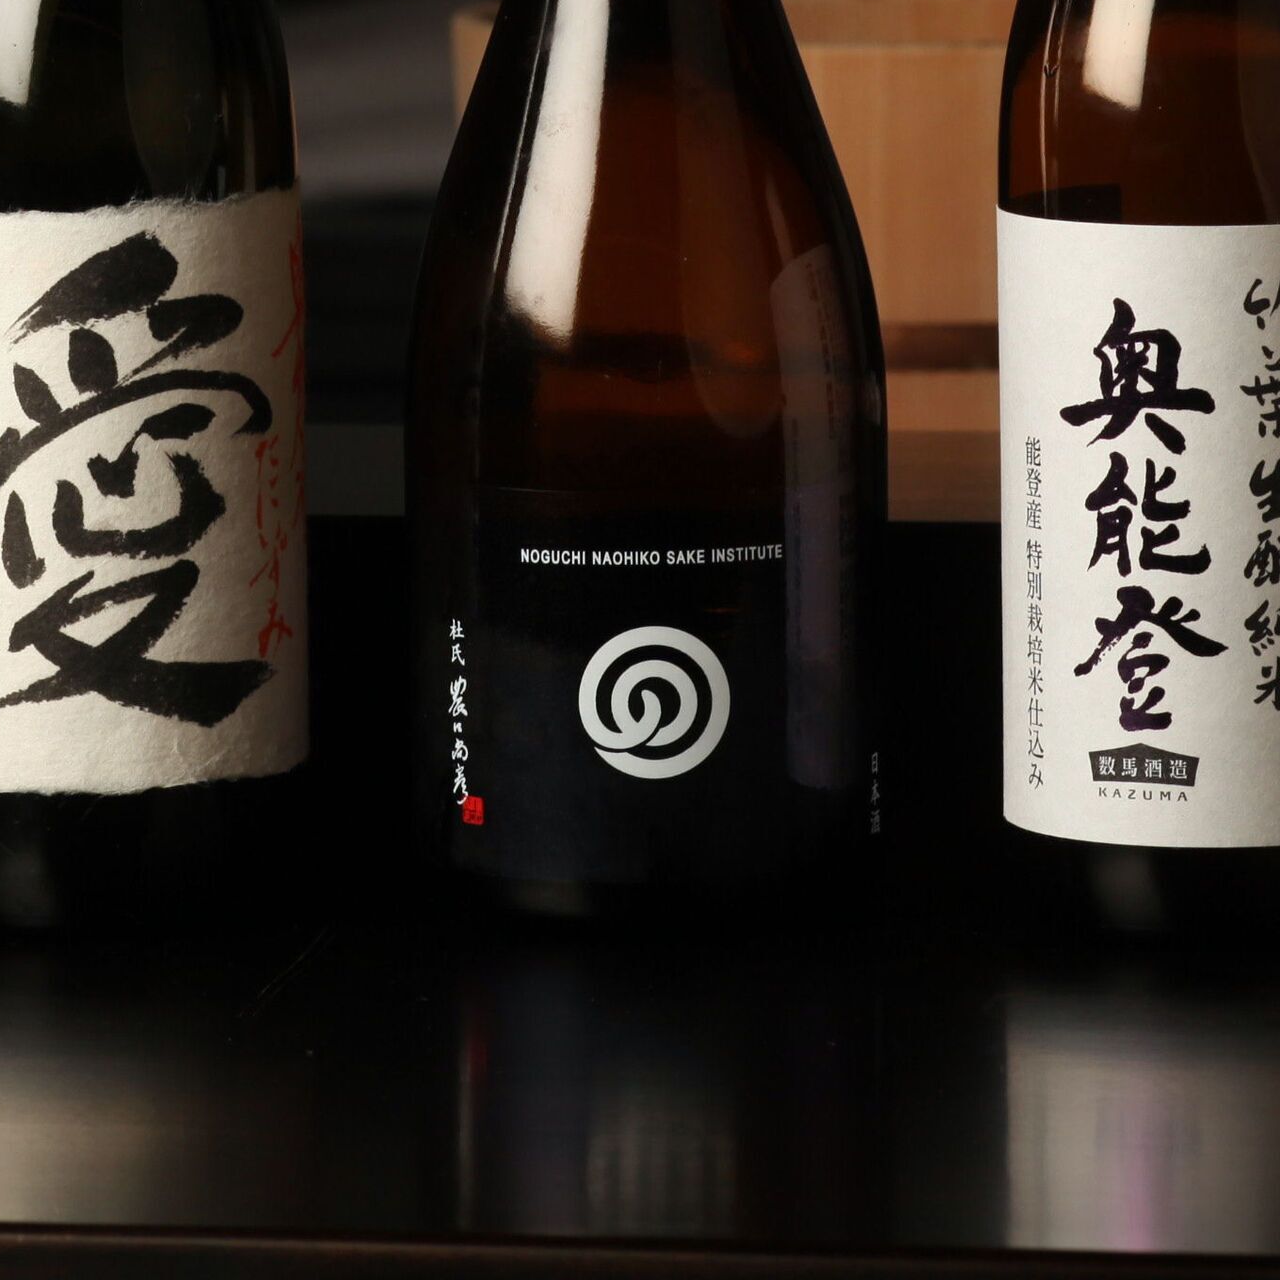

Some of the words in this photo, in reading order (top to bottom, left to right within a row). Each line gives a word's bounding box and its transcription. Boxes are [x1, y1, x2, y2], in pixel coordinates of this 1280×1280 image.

[1024, 436, 1043, 531] 能登産
[1059, 297, 1230, 733] 奥能登
[520, 548, 587, 566] NOGUCHI
[591, 549, 661, 566] NAOHIKO
[666, 549, 706, 565] SAKE
[711, 543, 783, 564] INSTITUTE
[449, 618, 466, 667] 杜氏
[1026, 538, 1045, 790] 特別栽培米仕込み
[1098, 786, 1189, 802] KAZUMA
[1099, 756, 1189, 784] 数馬酒造
